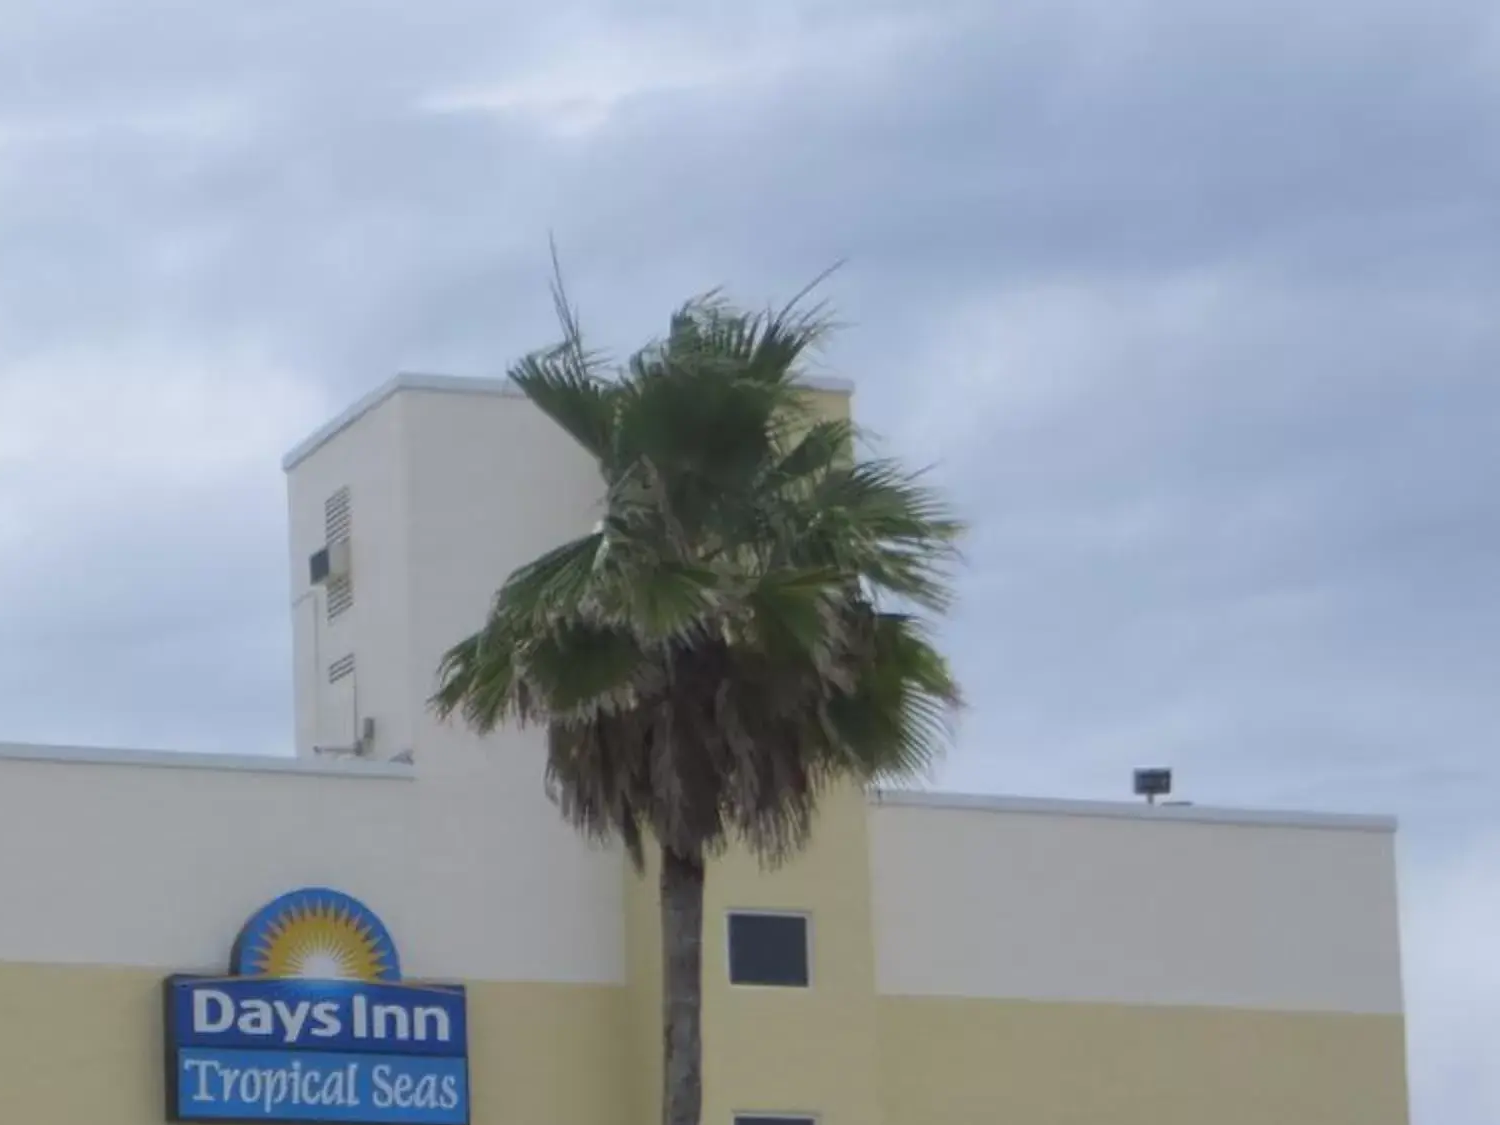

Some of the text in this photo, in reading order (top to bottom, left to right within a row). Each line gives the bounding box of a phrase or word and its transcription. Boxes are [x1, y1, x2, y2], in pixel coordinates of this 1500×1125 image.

[192, 989, 450, 1042] Days Inn
[184, 1058, 458, 1113] Tropical Seas
